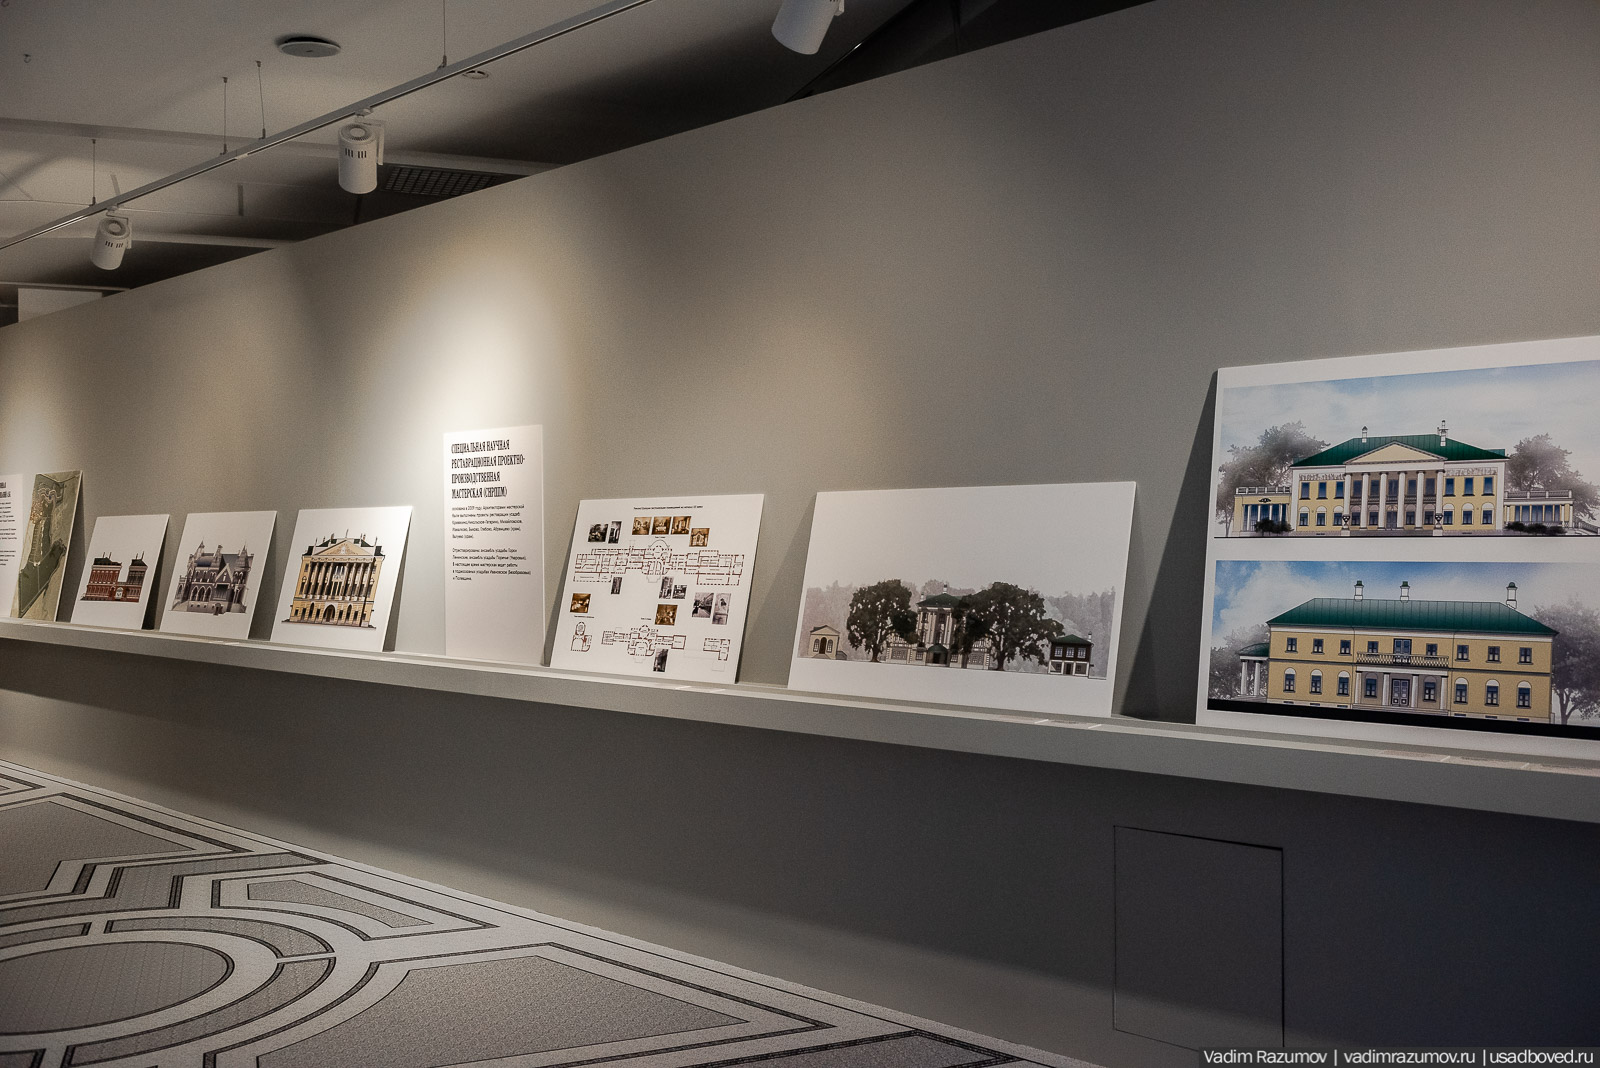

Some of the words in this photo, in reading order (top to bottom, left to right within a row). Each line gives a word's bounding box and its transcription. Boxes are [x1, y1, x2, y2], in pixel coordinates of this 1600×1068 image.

[451, 441, 486, 454] СПЕЦИАЛЬНАЯ
[486, 440, 510, 452] НАУЧНАЯ
[451, 456, 497, 469] РЕСТАВРАЦИОННАЯ
[498, 454, 526, 466] ПРОЕКТНО-
[451, 471, 500, 484] ПРОИЗВОДСТВЕННАЯ
[451, 488, 483, 499] МАСТЕРСКАЯ
